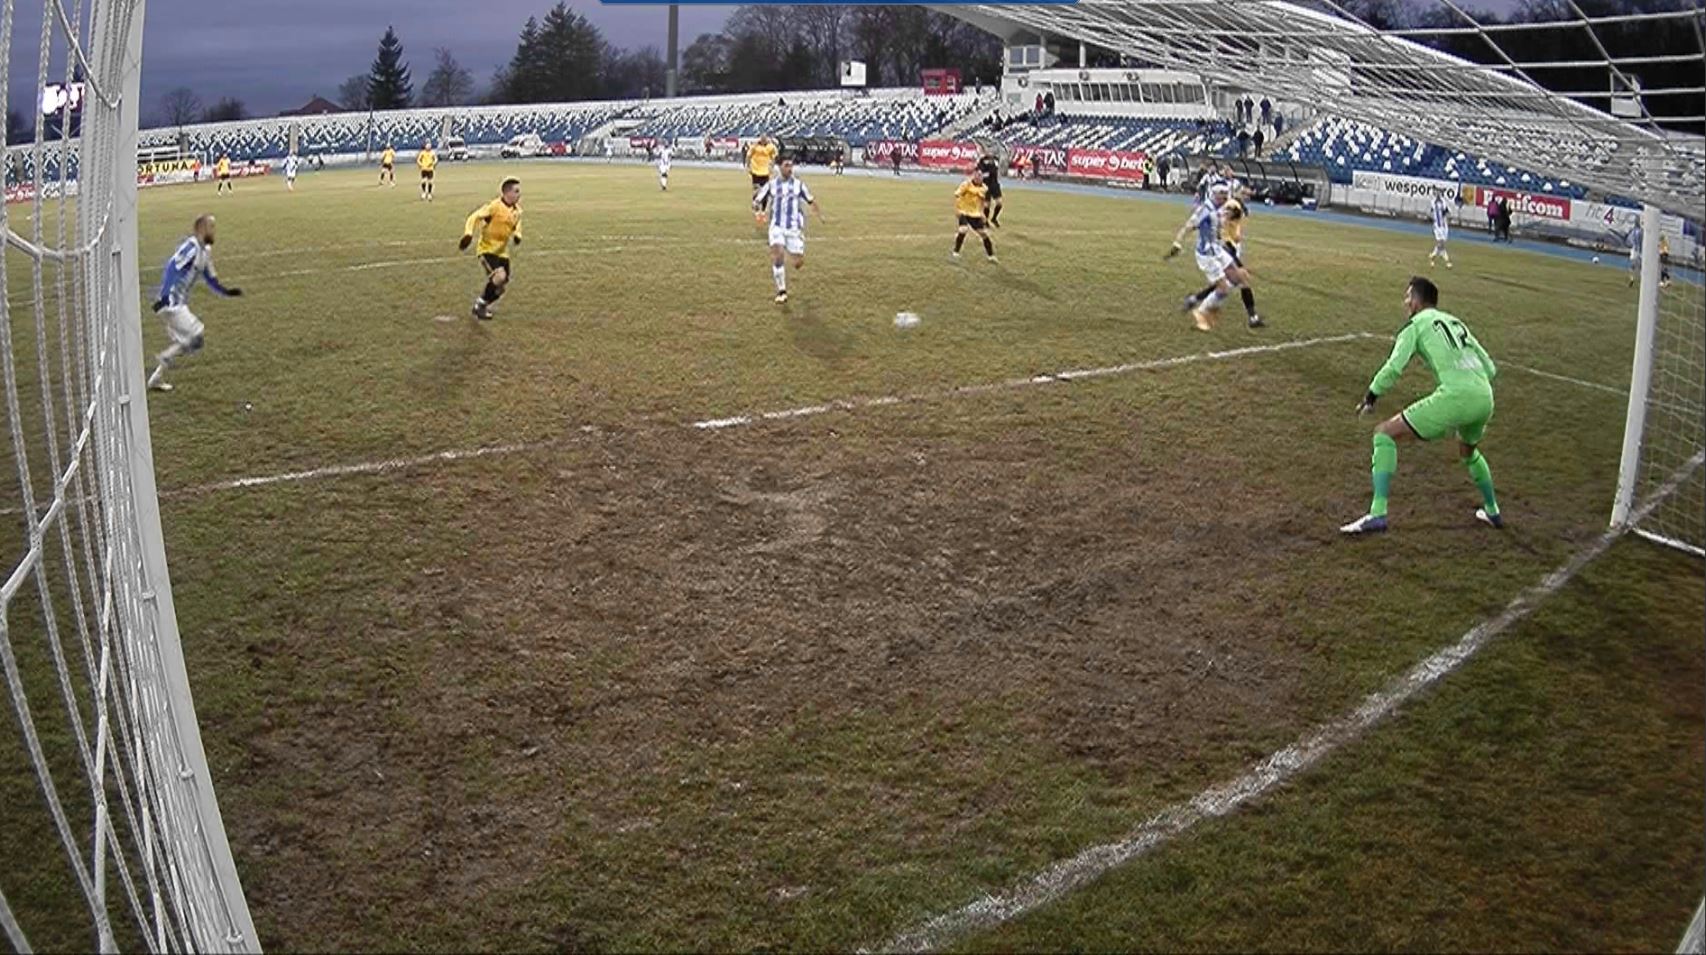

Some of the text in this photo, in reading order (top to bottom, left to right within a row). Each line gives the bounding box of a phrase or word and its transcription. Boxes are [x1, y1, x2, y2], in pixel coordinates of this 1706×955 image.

[879, 143, 919, 158] AVTAR
[137, 161, 188, 174] ORTUNA
[1071, 155, 1144, 170] super bet
[1384, 180, 1455, 199] wesportro
[1432, 320, 1474, 351] 12
